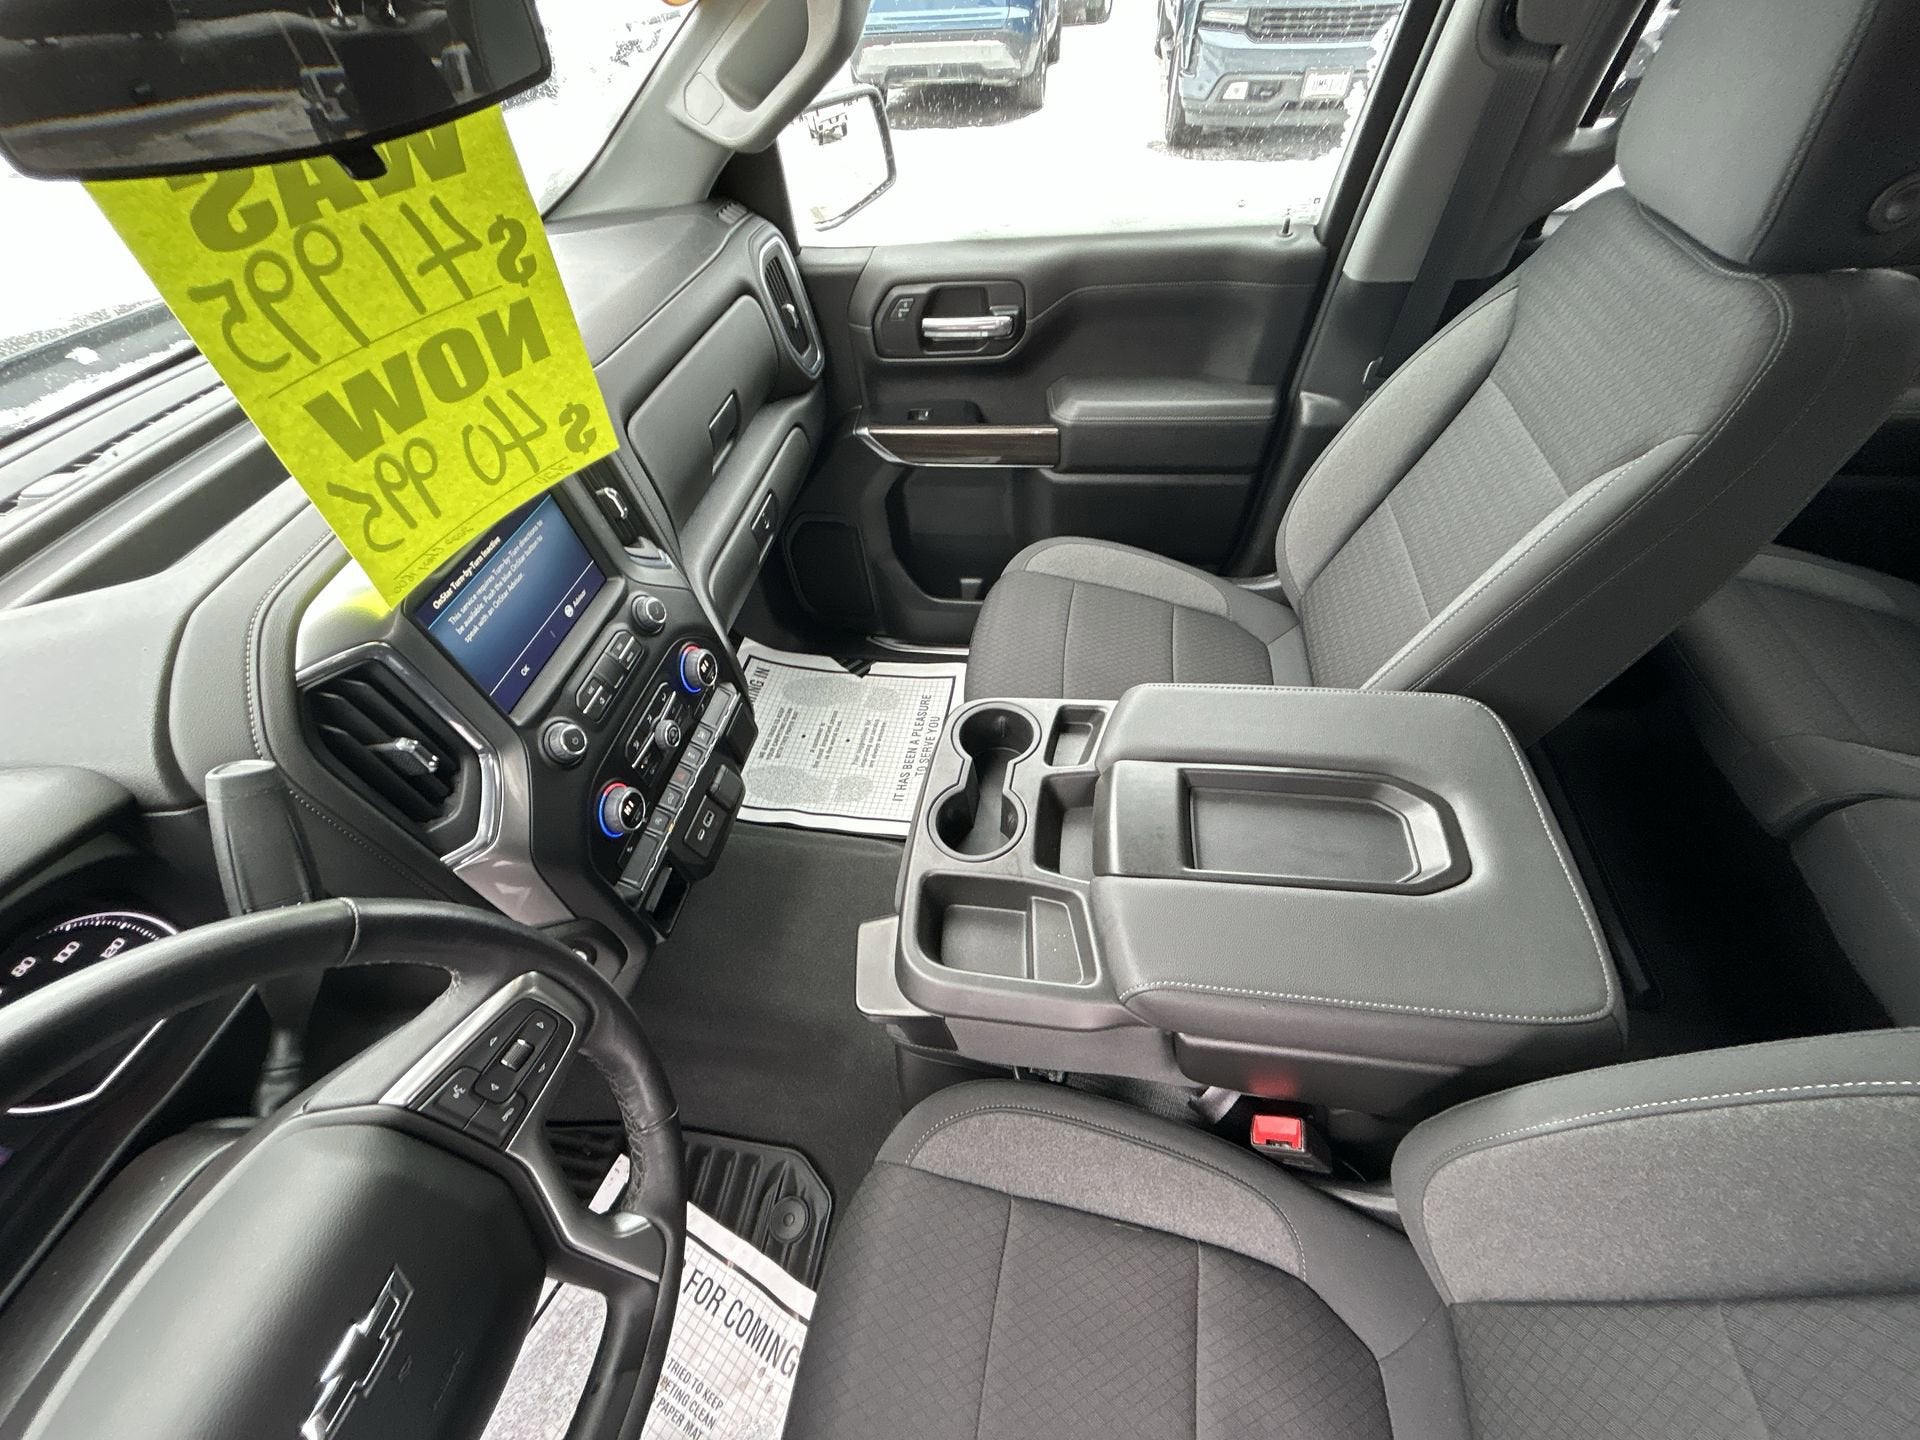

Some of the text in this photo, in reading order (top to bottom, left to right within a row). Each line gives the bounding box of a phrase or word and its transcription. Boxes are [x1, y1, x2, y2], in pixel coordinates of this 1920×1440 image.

[432, 536, 500, 609] OnStar Turn-by-Turn Inactive
[447, 612, 461, 624] This
[460, 593, 477, 613] service
[475, 574, 494, 595] requires
[491, 545, 519, 575] Turn-by-Turn
[518, 525, 538, 547] directions
[455, 625, 464, 634] be
[482, 589, 496, 603] Push
[494, 580, 503, 590] the
[501, 570, 512, 582] blue
[510, 554, 525, 572] OnStar
[464, 624, 479, 642] speak
[477, 613, 488, 627] with
[487, 607, 494, 615] an
[492, 589, 508, 608] OnStar
[520, 664, 529, 676] OK
[757, 666, 770, 680] IN
[911, 694, 931, 736] PLEASURE
[902, 747, 917, 769] BEEN
[914, 716, 940, 778] TO SERVE YOU
[891, 792, 904, 801] IT
[895, 771, 910, 790] HAS
[11, 956, 36, 977] 80
[53, 941, 80, 963] 100
[683, 1268, 801, 1378] FOR COMING
[660, 1375, 717, 1430] PETING CLEAN
[667, 1358, 723, 1411] TRIED TO KEEP
[656, 1397, 702, 1440] PAPER MAT
